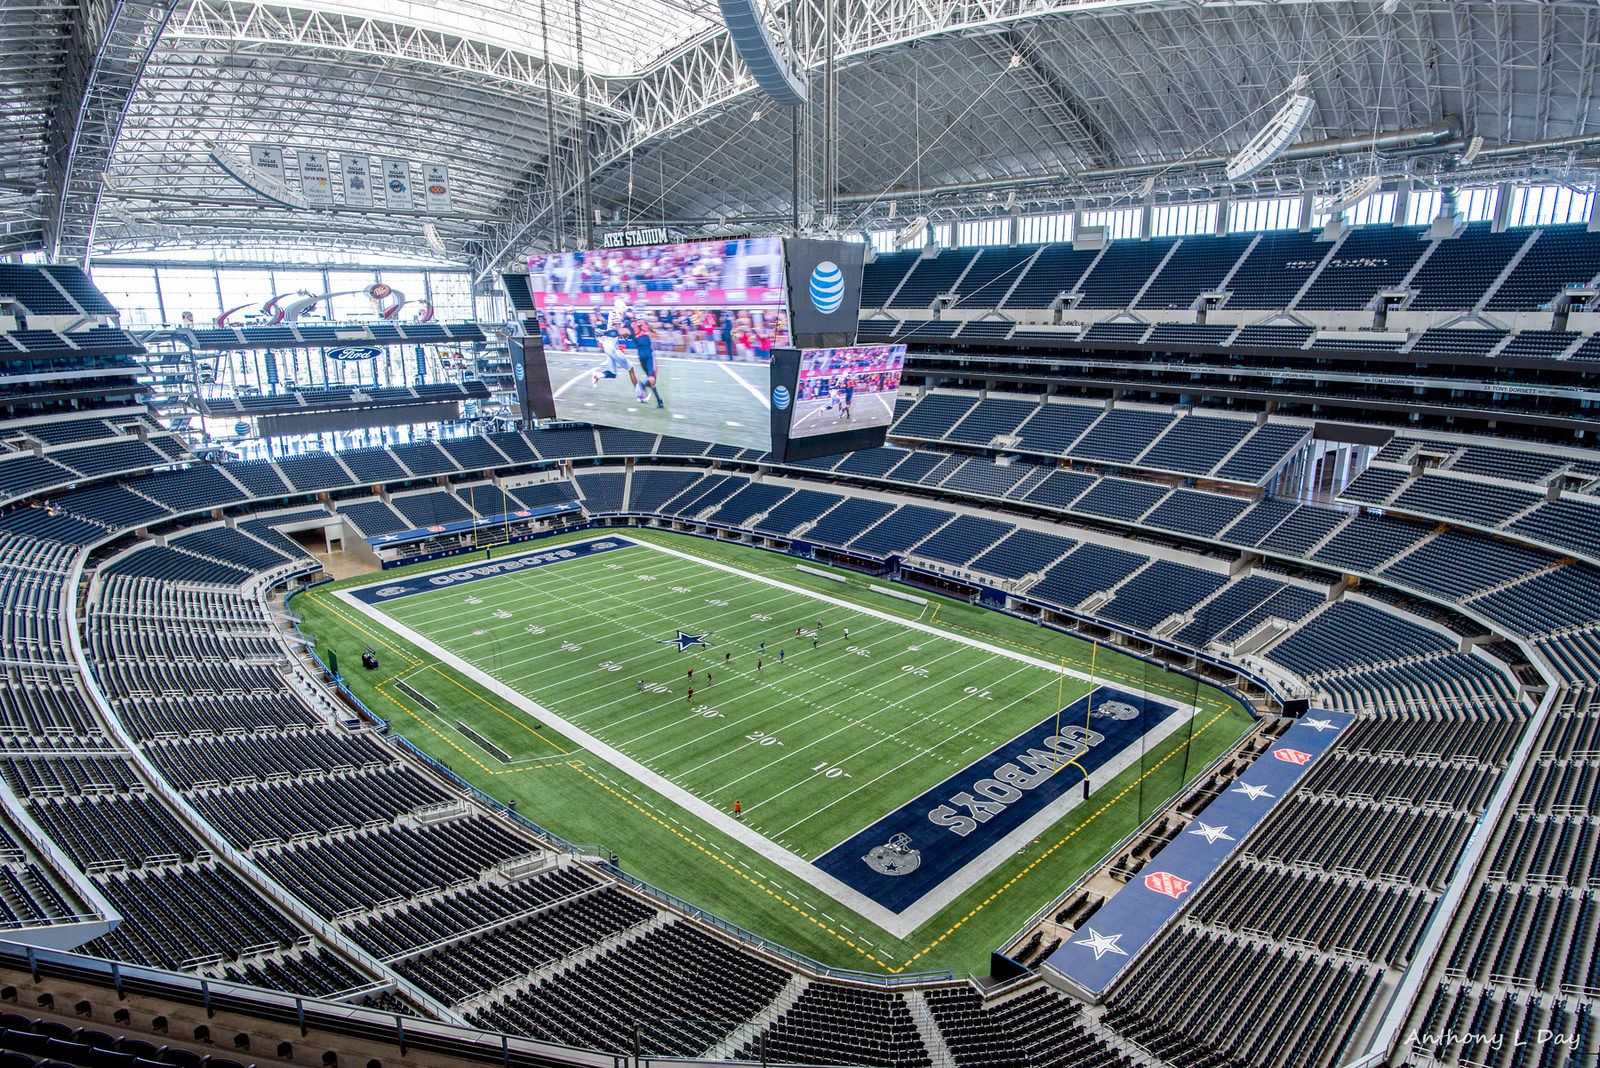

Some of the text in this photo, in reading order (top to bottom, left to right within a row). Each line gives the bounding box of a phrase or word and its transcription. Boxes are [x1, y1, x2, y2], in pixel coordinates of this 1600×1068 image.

[604, 228, 668, 248] AT&T STADIUM
[338, 348, 372, 359] Ford
[428, 549, 577, 586] COWBOYS
[690, 704, 718, 718] 30
[745, 731, 776, 746] 20
[810, 762, 843, 778] 10
[928, 725, 1106, 838] COWBOYS
